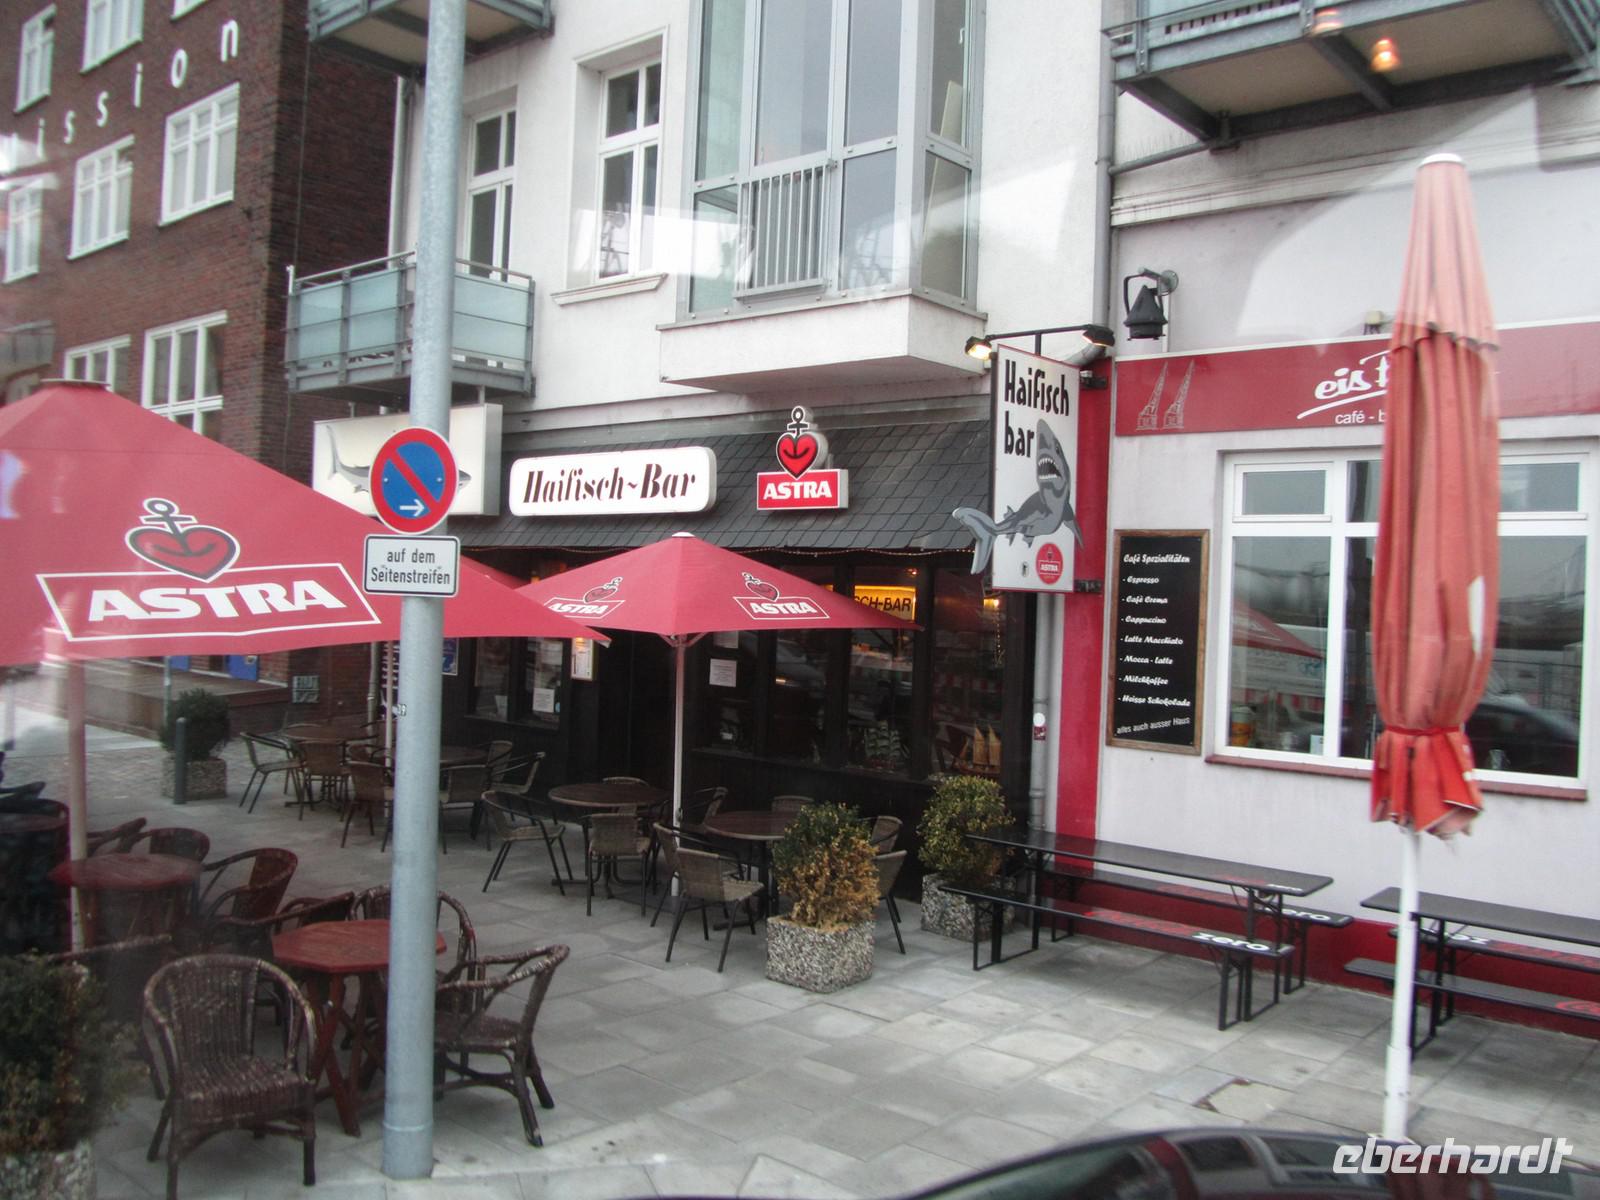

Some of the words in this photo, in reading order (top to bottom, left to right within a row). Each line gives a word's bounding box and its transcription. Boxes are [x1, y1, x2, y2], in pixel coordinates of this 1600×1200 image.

[1004, 359, 1070, 416] Haifisch
[1314, 367, 1372, 400] eis
[1335, 410, 1366, 425] café
[1004, 410, 1035, 458] bar
[763, 480, 833, 500] ASTRA
[387, 548, 406, 563] auf
[411, 548, 435, 563] dem
[371, 567, 451, 585] Seitenstreifen
[1127, 575, 1160, 584] Espresso
[88, 579, 348, 622] ASTRA
[1144, 595, 1169, 604] Crema
[750, 602, 818, 615] ASTRA
[1125, 615, 1167, 624] Cappuccino
[1124, 635, 1142, 643] Latte
[1124, 655, 1149, 663] Mocca
[1154, 656, 1173, 664] Latte
[1133, 722, 1149, 731] auch
[1150, 720, 1172, 729] ausser
[1172, 717, 1190, 725] Haus
[1192, 931, 1270, 951] zero
